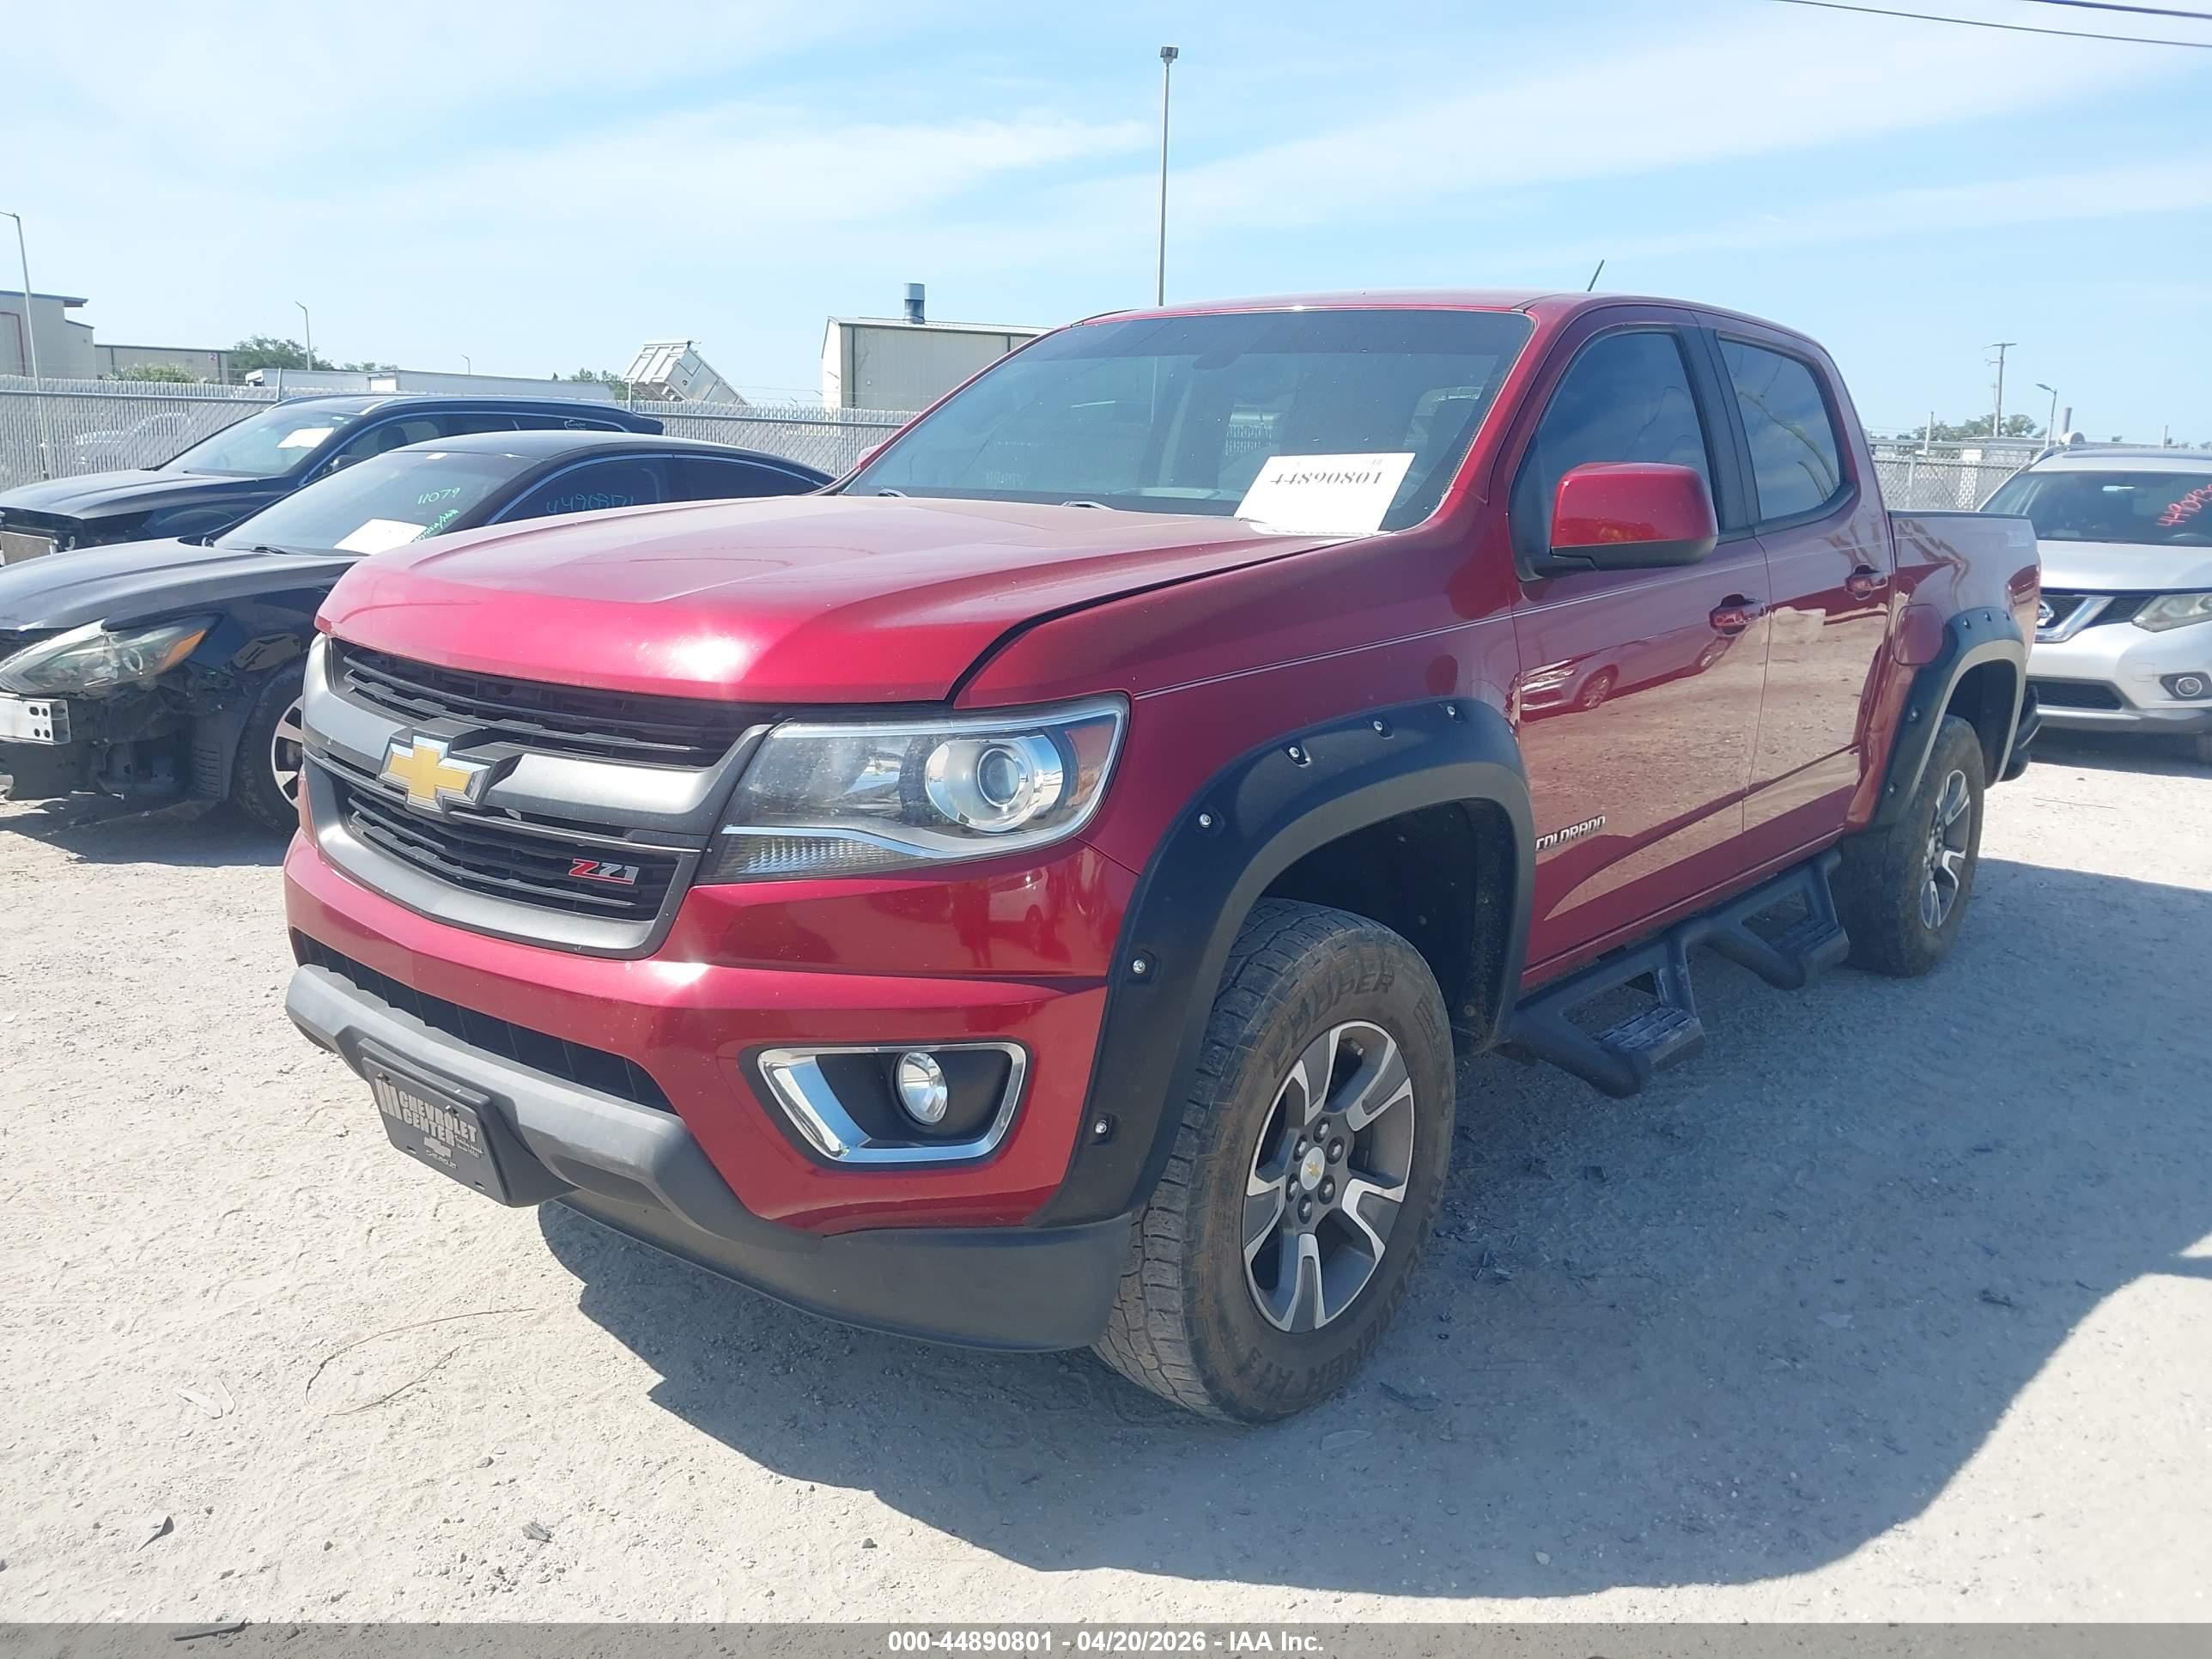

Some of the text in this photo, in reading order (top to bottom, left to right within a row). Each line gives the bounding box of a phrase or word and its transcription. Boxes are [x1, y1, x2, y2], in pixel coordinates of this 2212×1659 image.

[1270, 471, 1383, 485] 44890801
[1534, 815, 1606, 852] COLORADO
[568, 858, 640, 885] Z71
[398, 1090, 477, 1143] CHEVROLET
[403, 1108, 456, 1148] CENTER
